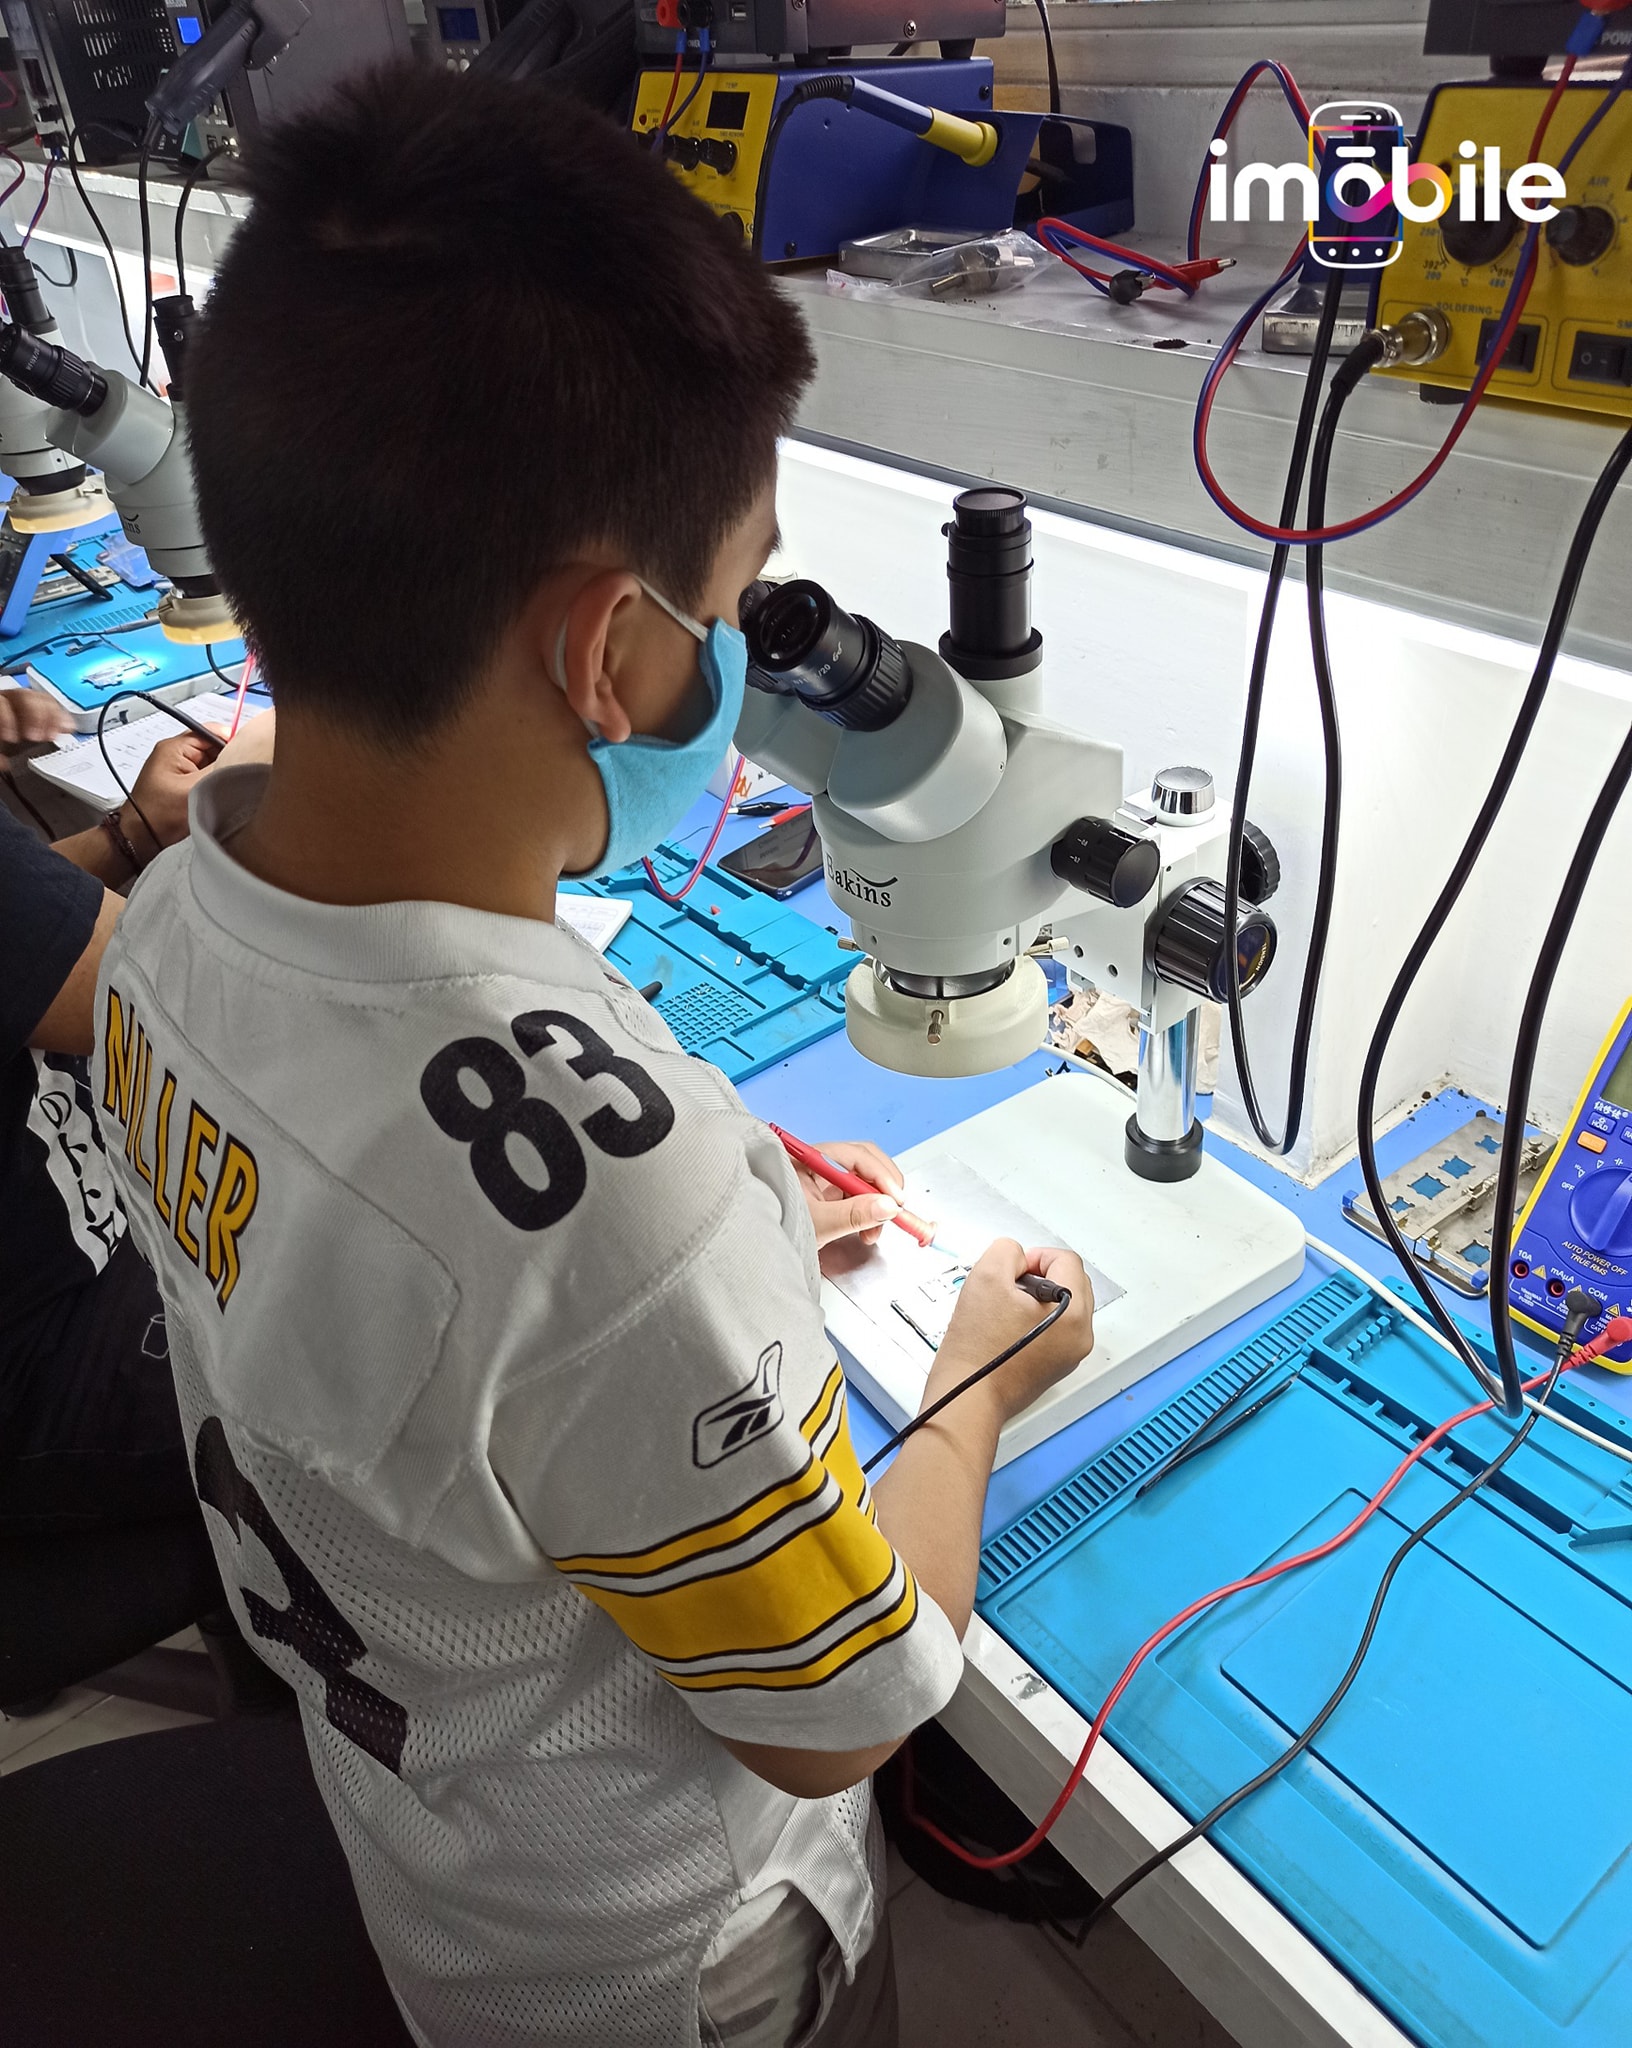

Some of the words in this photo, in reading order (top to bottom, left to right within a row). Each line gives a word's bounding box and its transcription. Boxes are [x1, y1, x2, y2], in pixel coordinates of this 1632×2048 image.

[1436, 301, 1493, 316] SOLDERING
[826, 852, 892, 908] Eakins
[420, 1010, 675, 1231] 83
[1591, 1119, 1608, 1131] HOLD
[1561, 1181, 1575, 1191] OFF
[1517, 1249, 1533, 1262] 10A
[1561, 1240, 1583, 1254] AUTO
[1583, 1250, 1612, 1269] POWER
[1610, 1264, 1629, 1276] OFF
[1570, 1252, 1591, 1268] TRUE
[1589, 1262, 1608, 1277] RMS
[1518, 1295, 1534, 1308] FUSED
[1587, 1286, 1608, 1302] COM
